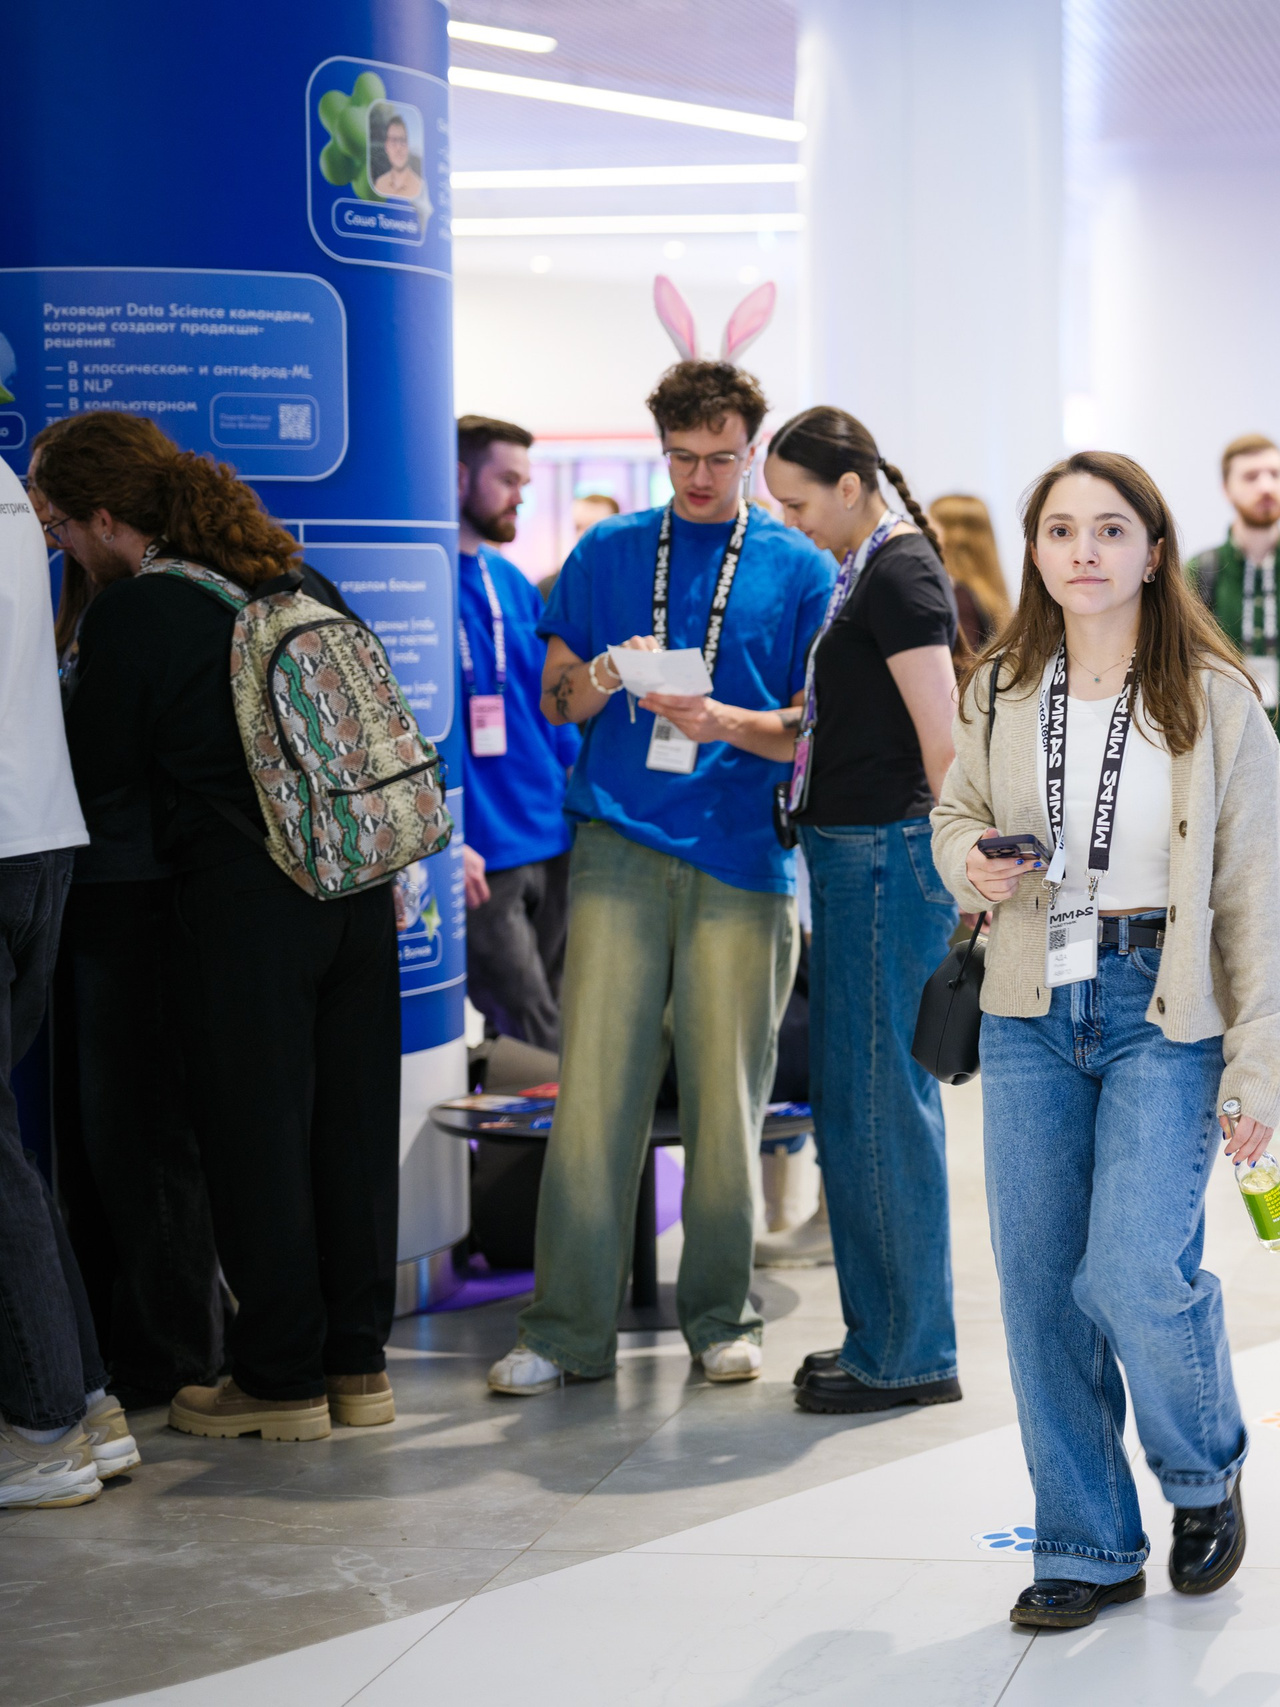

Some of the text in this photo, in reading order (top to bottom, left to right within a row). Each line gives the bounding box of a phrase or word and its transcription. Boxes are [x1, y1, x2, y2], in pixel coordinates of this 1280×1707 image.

[43, 303, 122, 319] Руководит
[126, 303, 164, 317] Data
[169, 303, 225, 318] Science
[43, 321, 265, 336] которые создают продакшн-
[44, 337, 116, 350] решения:
[199, 365, 208, 375] и
[83, 379, 113, 393] NLP
[83, 400, 197, 413] компьютерном
[370, 651, 410, 731] adidas
